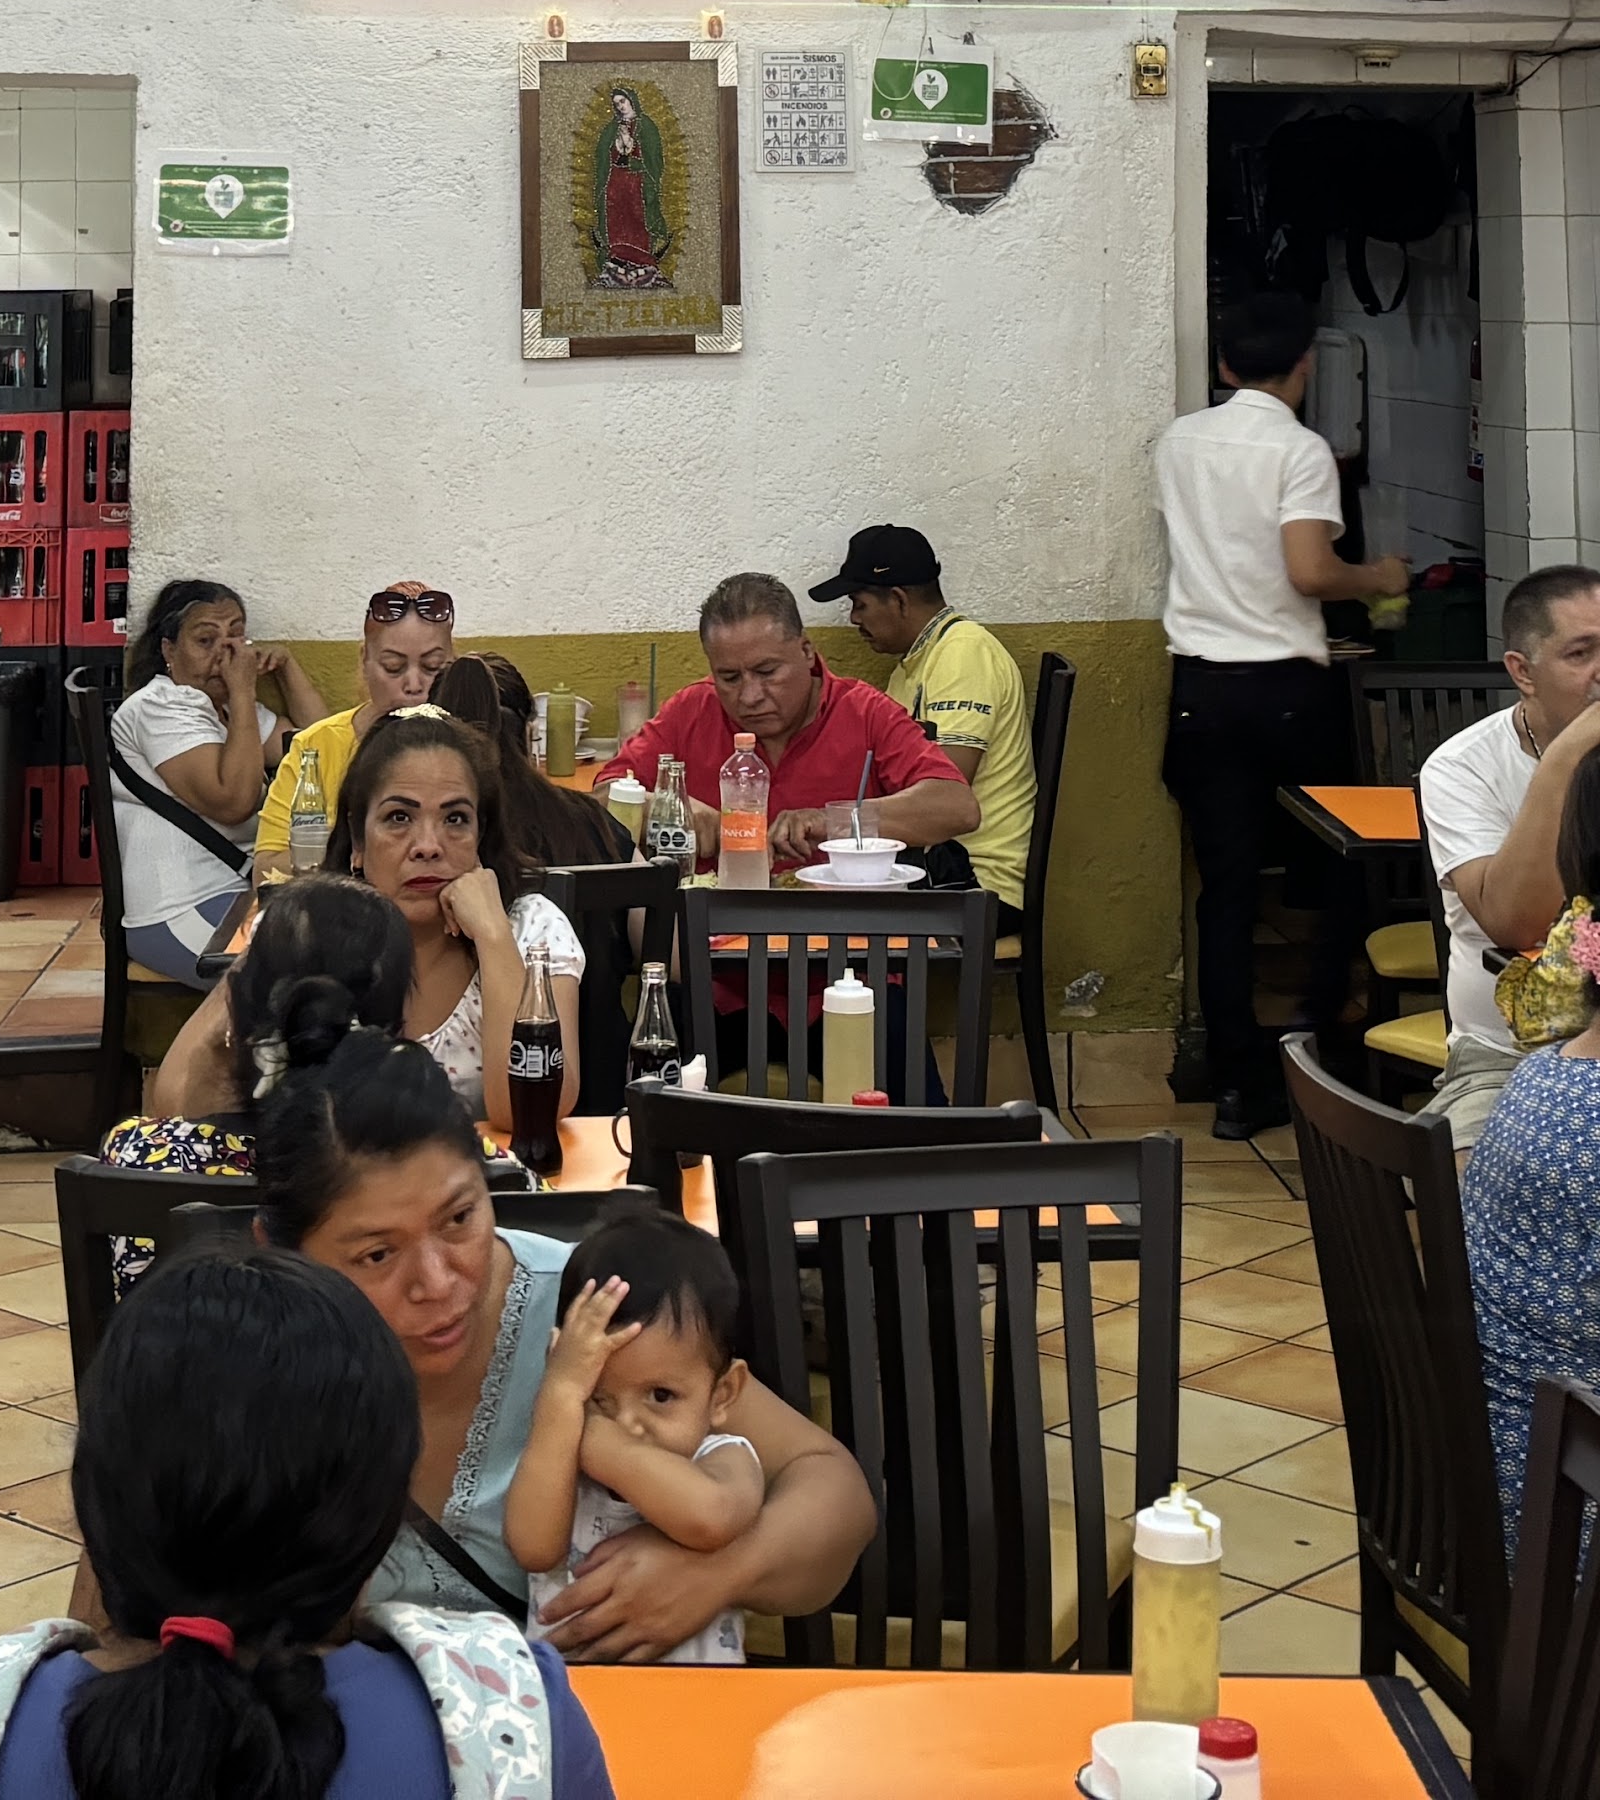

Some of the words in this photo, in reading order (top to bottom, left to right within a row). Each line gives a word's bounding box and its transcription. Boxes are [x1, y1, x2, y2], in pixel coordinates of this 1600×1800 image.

[803, 54, 837, 63] SISMOS
[782, 102, 828, 110] INCENDIOS
[926, 700, 957, 711] REE
[957, 700, 992, 715] FIRE
